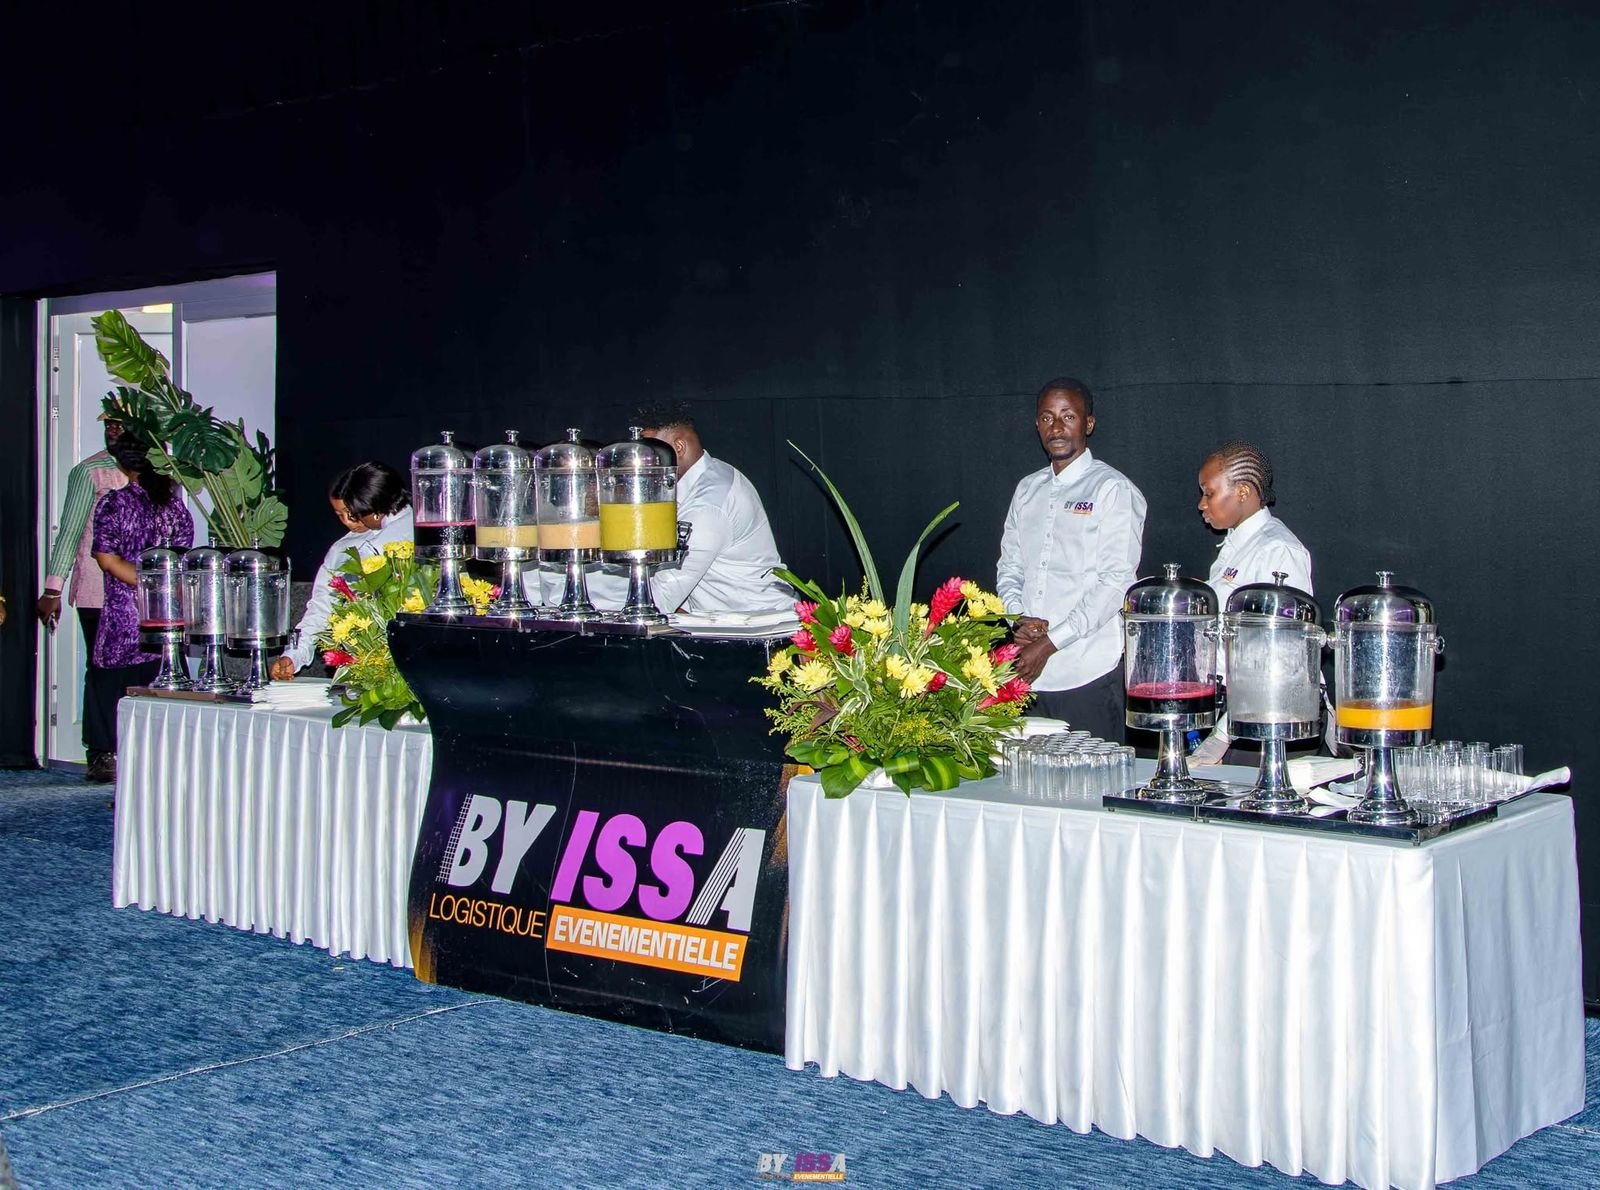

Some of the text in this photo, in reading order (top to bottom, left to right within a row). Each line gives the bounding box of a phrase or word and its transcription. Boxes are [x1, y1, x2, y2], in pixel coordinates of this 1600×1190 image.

[1074, 501, 1094, 512] ISSA
[435, 793, 766, 932] BY ISSA
[429, 893, 741, 971] LOGISTIQUE EVENEMENTIELLE
